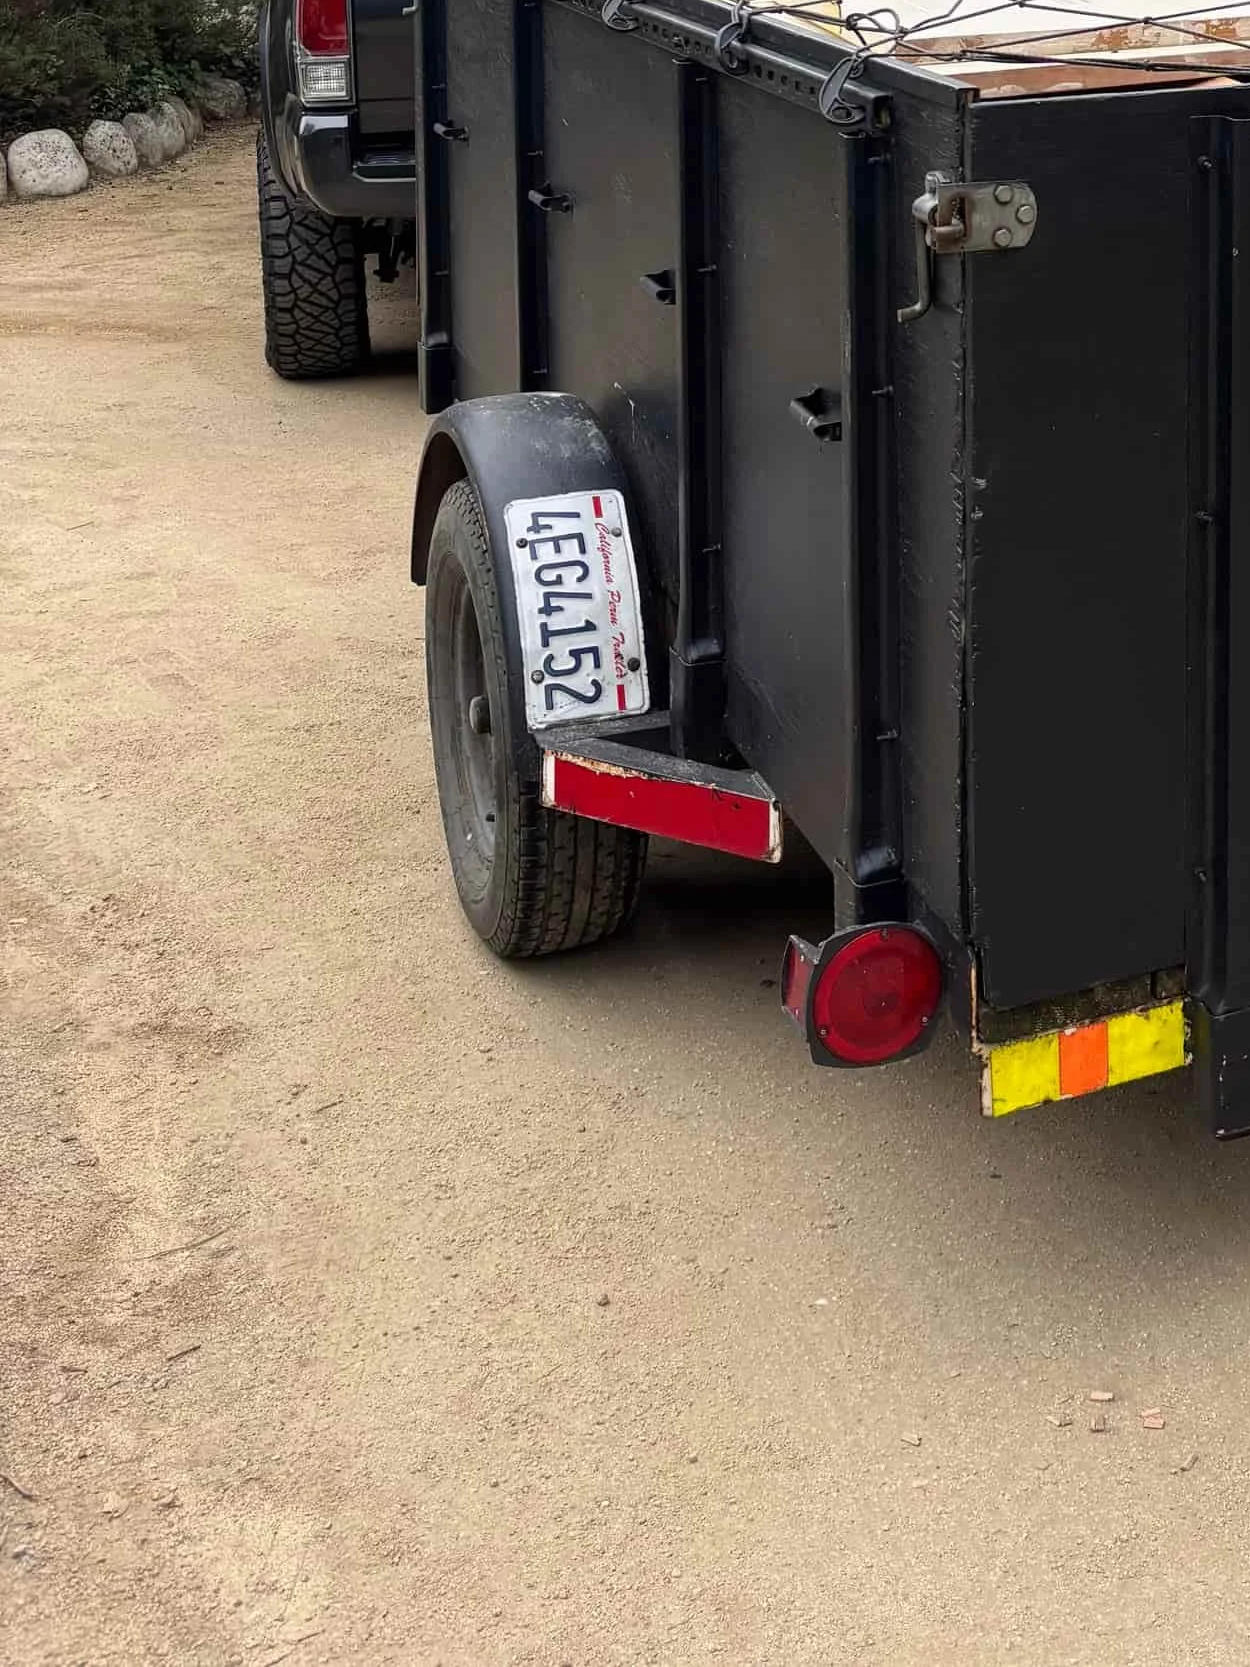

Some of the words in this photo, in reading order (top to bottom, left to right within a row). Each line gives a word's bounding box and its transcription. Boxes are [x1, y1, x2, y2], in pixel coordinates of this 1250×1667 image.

[526, 510, 603, 711] 4EG4152
[594, 521, 615, 585] California
[606, 590, 623, 625] Perm
